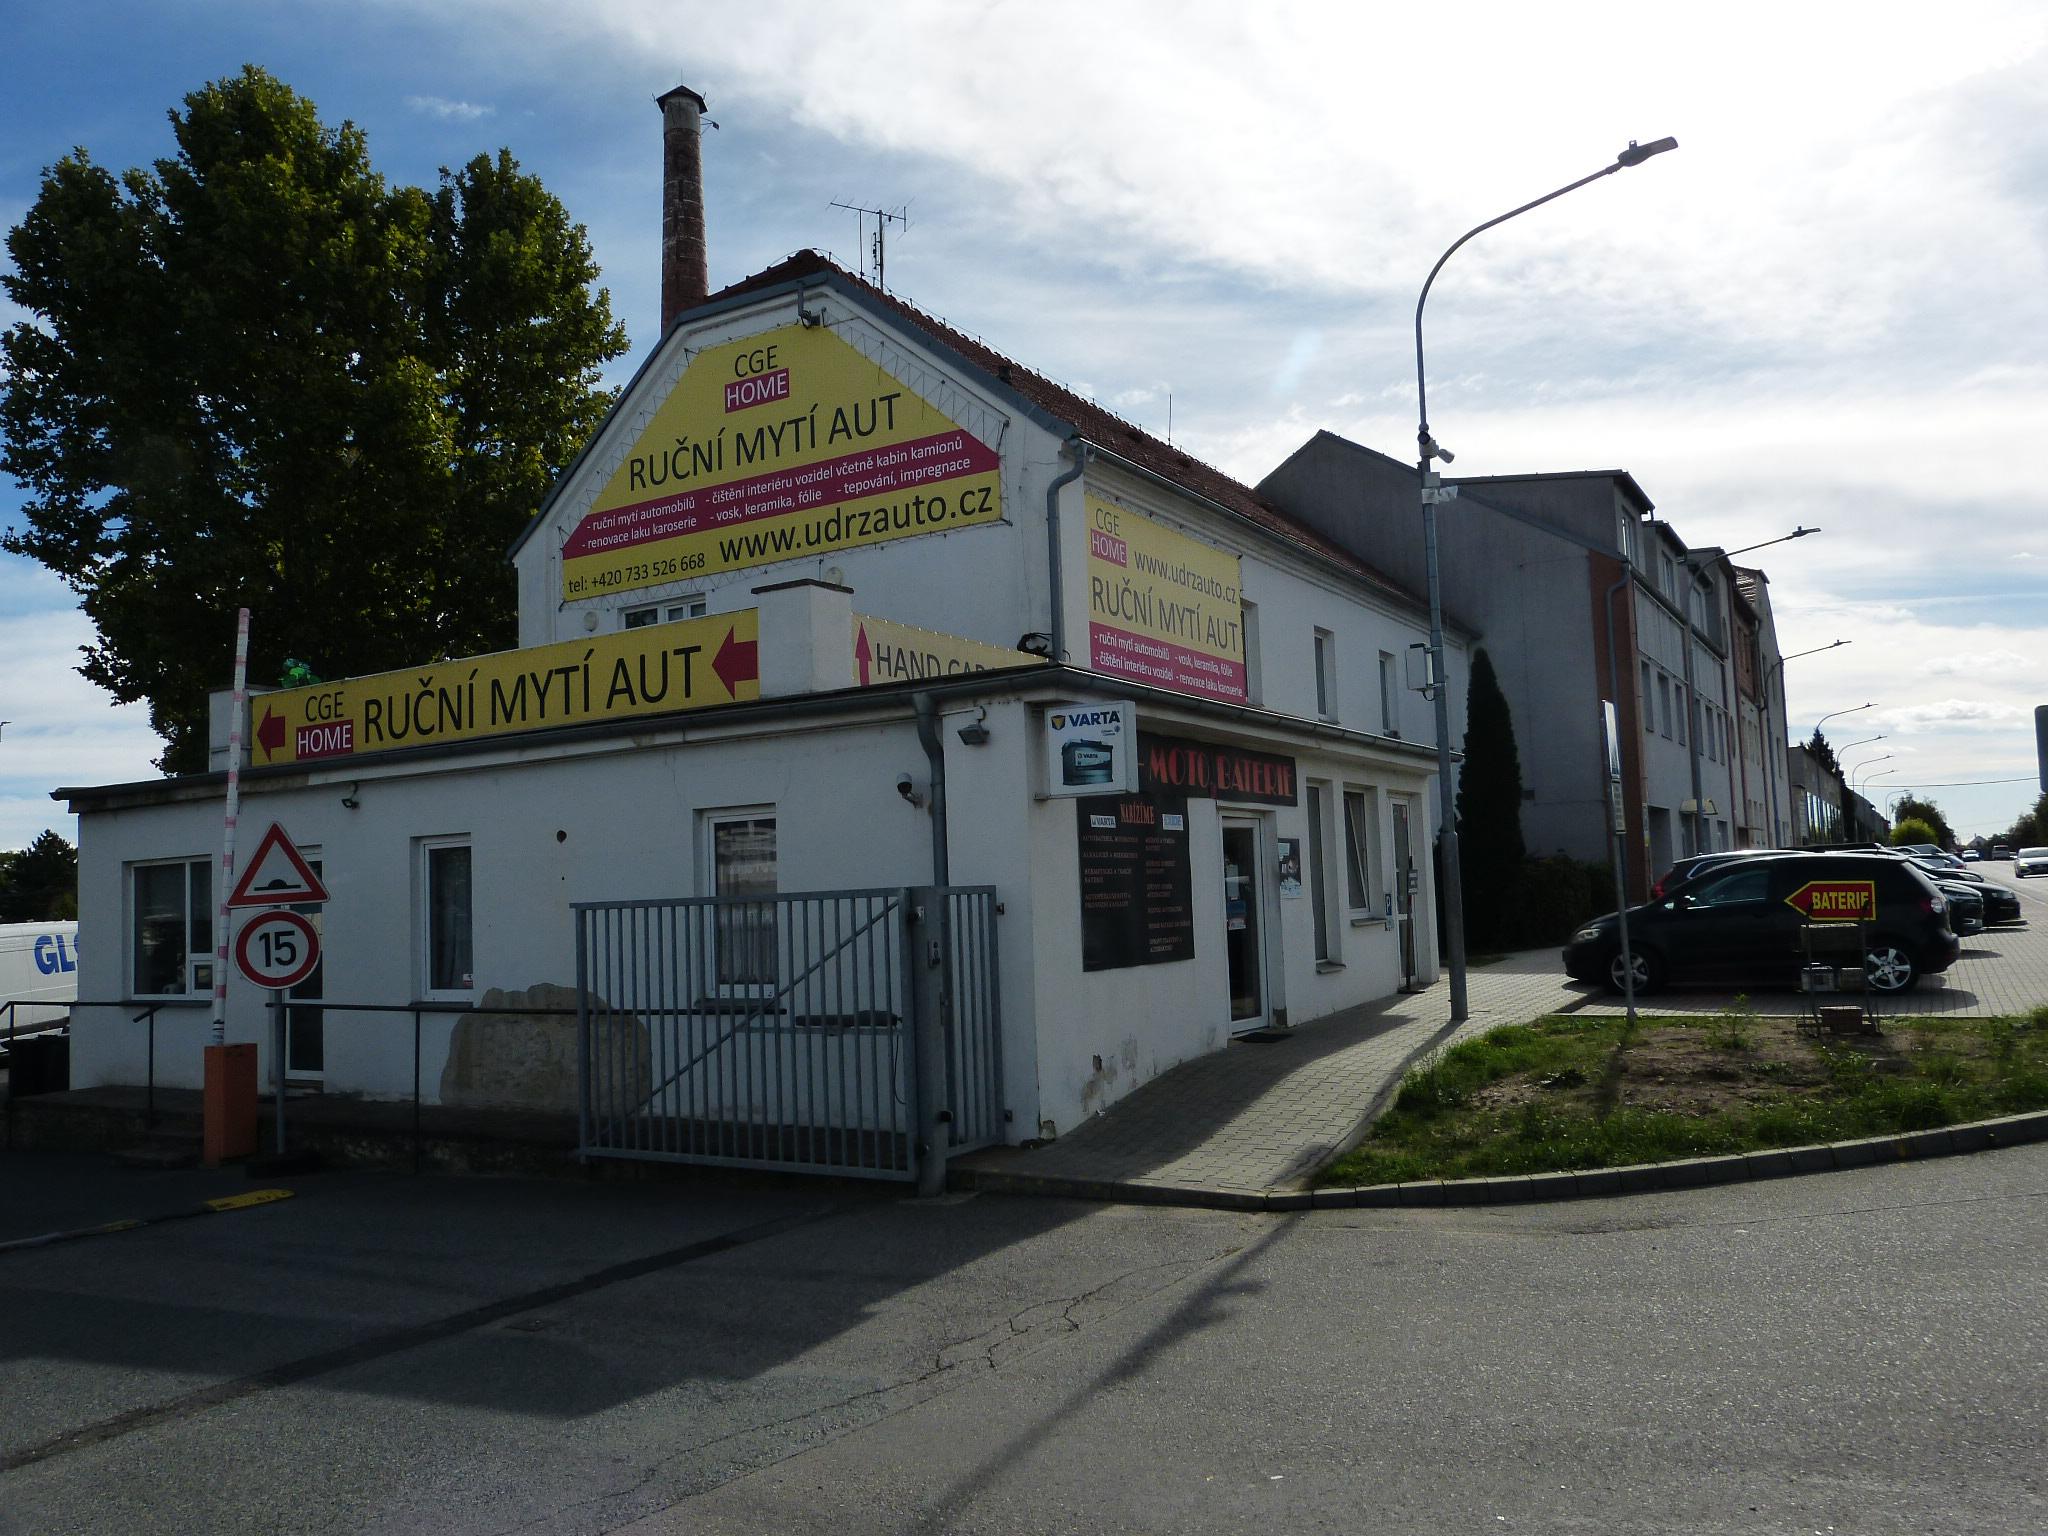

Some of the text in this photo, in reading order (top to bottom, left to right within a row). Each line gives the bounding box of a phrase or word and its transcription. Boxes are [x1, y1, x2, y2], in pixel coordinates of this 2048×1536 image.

[734, 344, 779, 378] CGE
[726, 372, 788, 409] HOME
[630, 392, 901, 492] RUČNÍ MYTÍ AUT
[712, 436, 963, 504] čištění interiéru vozidel včetně kabin kamionů
[843, 457, 971, 495] tepování, impregnace
[592, 496, 695, 531] ruční mytí automobilů
[716, 488, 822, 522] vosk, keramika, fólie
[1094, 507, 1121, 537] CGE
[587, 515, 697, 549] renovace laku karoserie
[719, 486, 993, 564] www.udrzauto.cz
[1091, 531, 1127, 564] HOME
[568, 552, 705, 594] tel: +420 733 526 668
[1134, 550, 1238, 605] www.udrzauto.cz
[1091, 576, 1238, 653] RUČNÍ MYTÍ AUT
[876, 642, 942, 680] HAND
[1099, 632, 1118, 648] ruční
[1134, 640, 1170, 662] automobilů
[1123, 658, 1153, 676] interiéru
[1152, 664, 1174, 680] vozidel
[305, 691, 345, 723] CGE
[364, 645, 702, 744] RUČNÍ MYTÍ AUT
[1068, 710, 1120, 727] VARTA
[298, 724, 352, 755] HOME
[1150, 745, 1293, 797] MOTO BATERIE
[258, 930, 297, 968] 15
